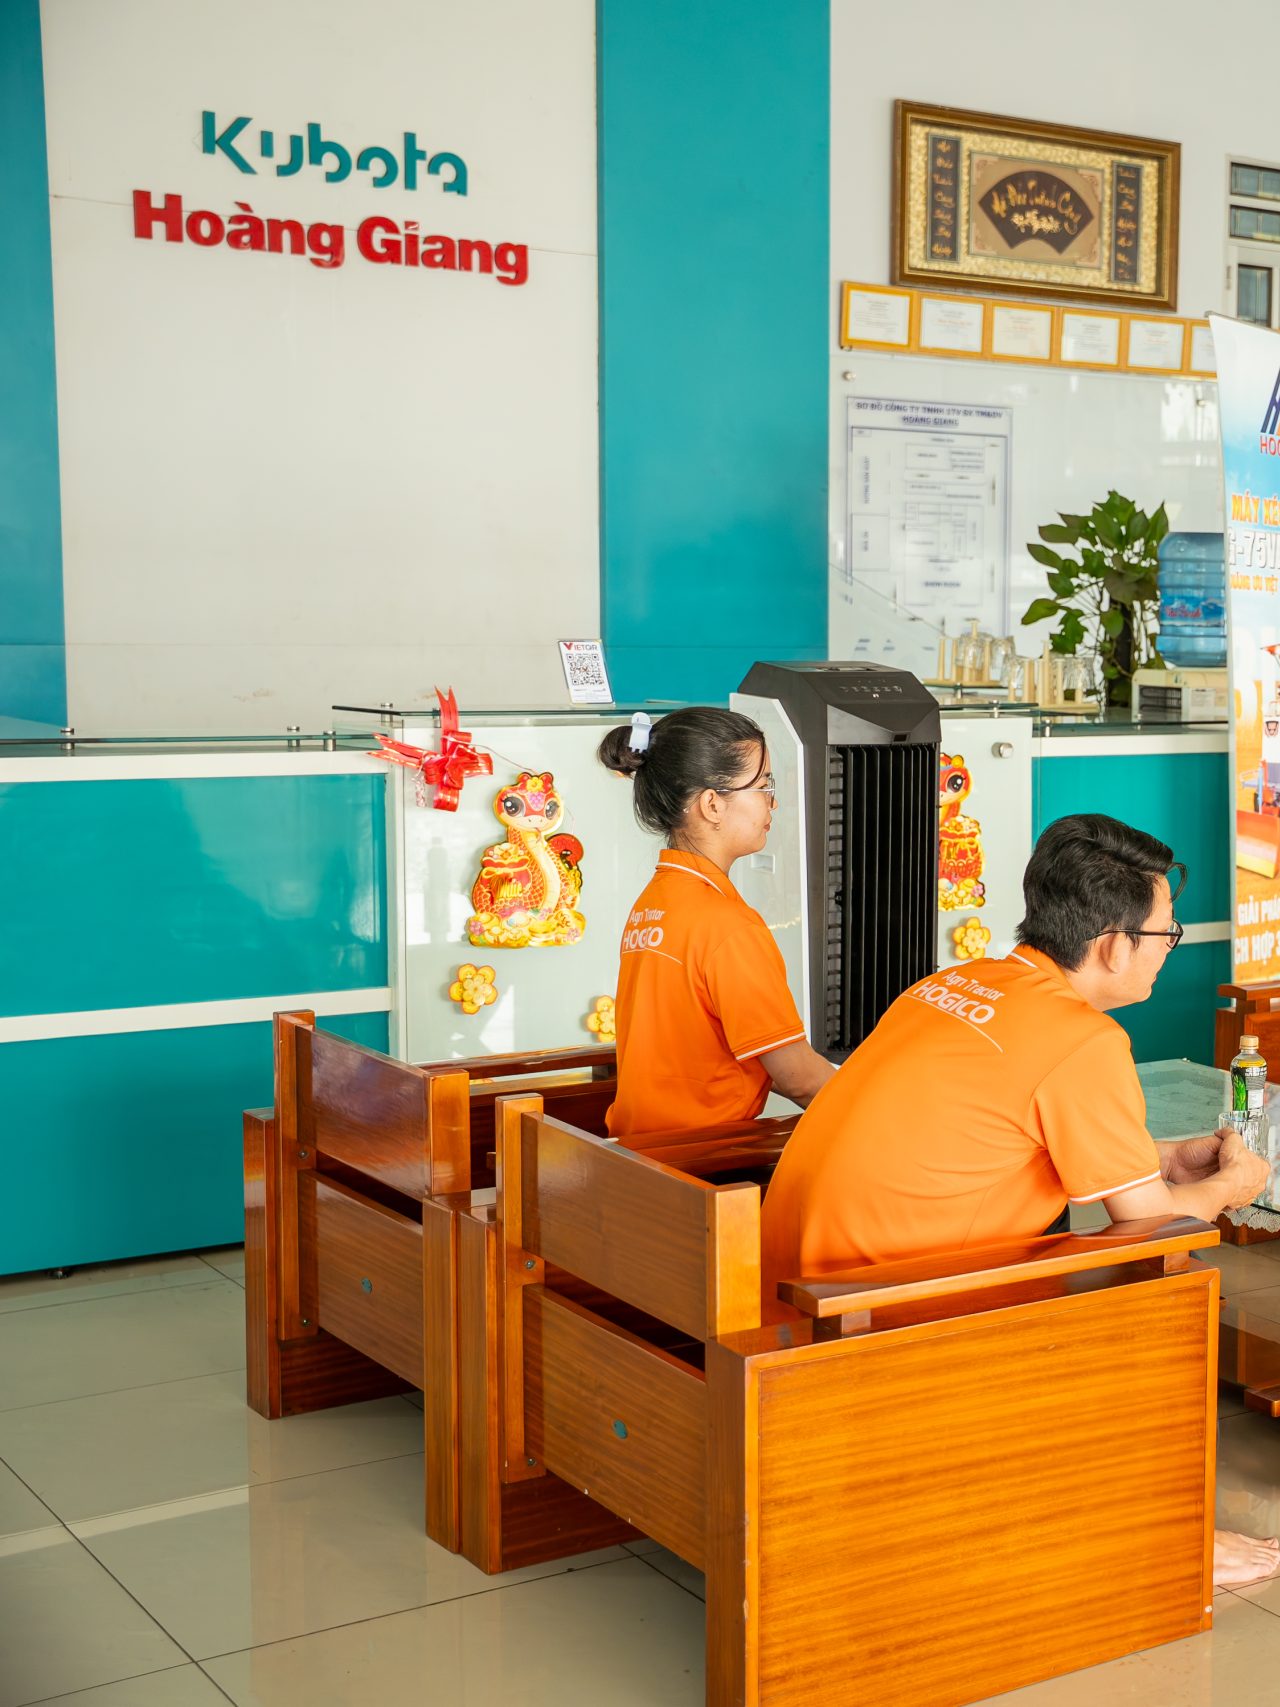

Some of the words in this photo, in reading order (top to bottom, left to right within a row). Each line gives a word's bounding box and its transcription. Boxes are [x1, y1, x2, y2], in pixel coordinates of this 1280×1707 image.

[202, 110, 467, 196] Kubota
[133, 189, 345, 269] Hoàng
[356, 214, 528, 286] Giang
[885, 401, 908, 413] CÔNG
[1231, 490, 1259, 524] MÁY
[1252, 930, 1274, 965] HỢP
[913, 980, 995, 1024] HOGICO
[964, 979, 1005, 1001] Tractor
